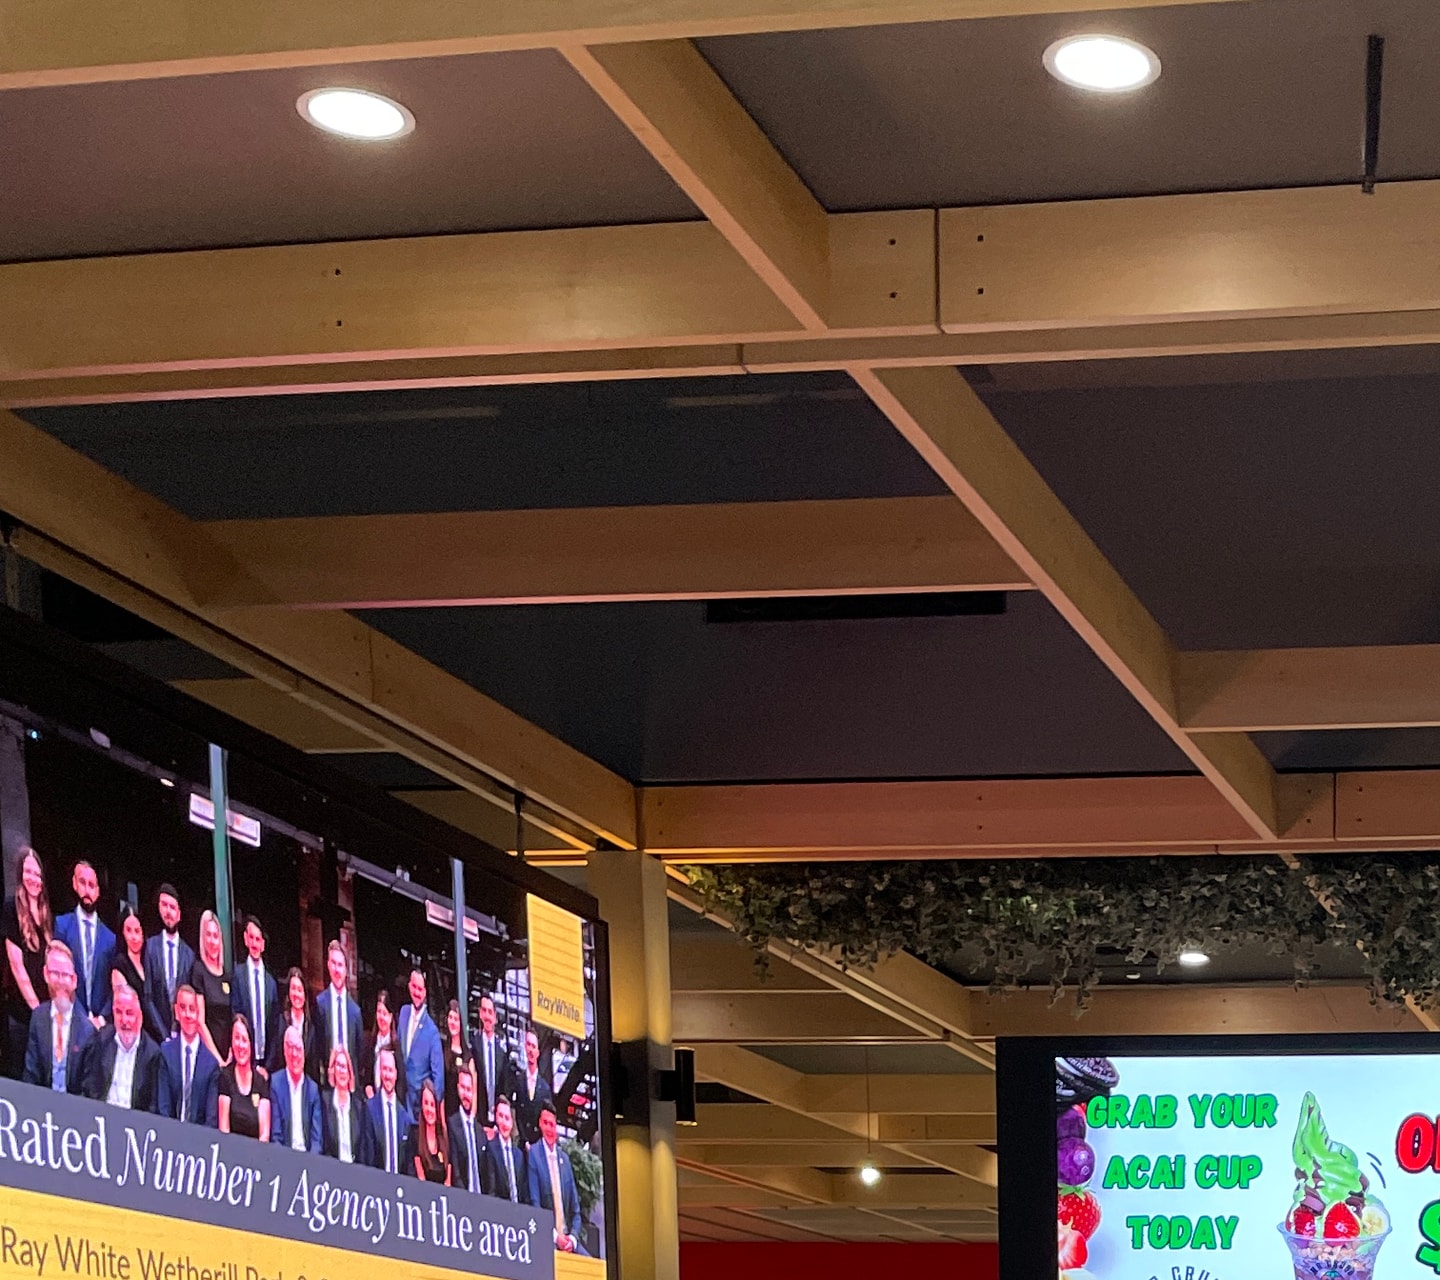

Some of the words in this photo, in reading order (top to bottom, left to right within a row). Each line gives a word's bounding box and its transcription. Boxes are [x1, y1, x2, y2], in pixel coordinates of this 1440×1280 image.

[1085, 1094, 1177, 1129] GRAB
[1189, 1092, 1278, 1129] YOUR
[0, 1097, 111, 1180] Rated
[116, 1127, 262, 1207] Number
[268, 1174, 281, 1213] 1
[287, 1168, 390, 1244] Agency
[396, 1187, 426, 1242] in
[429, 1196, 473, 1252] the
[1102, 1154, 1187, 1190] ACAI
[1195, 1153, 1263, 1189] CUP
[1126, 1214, 1240, 1251] TODAY
[1, 1225, 48, 1277] Ray
[54, 1234, 131, 1280] White
